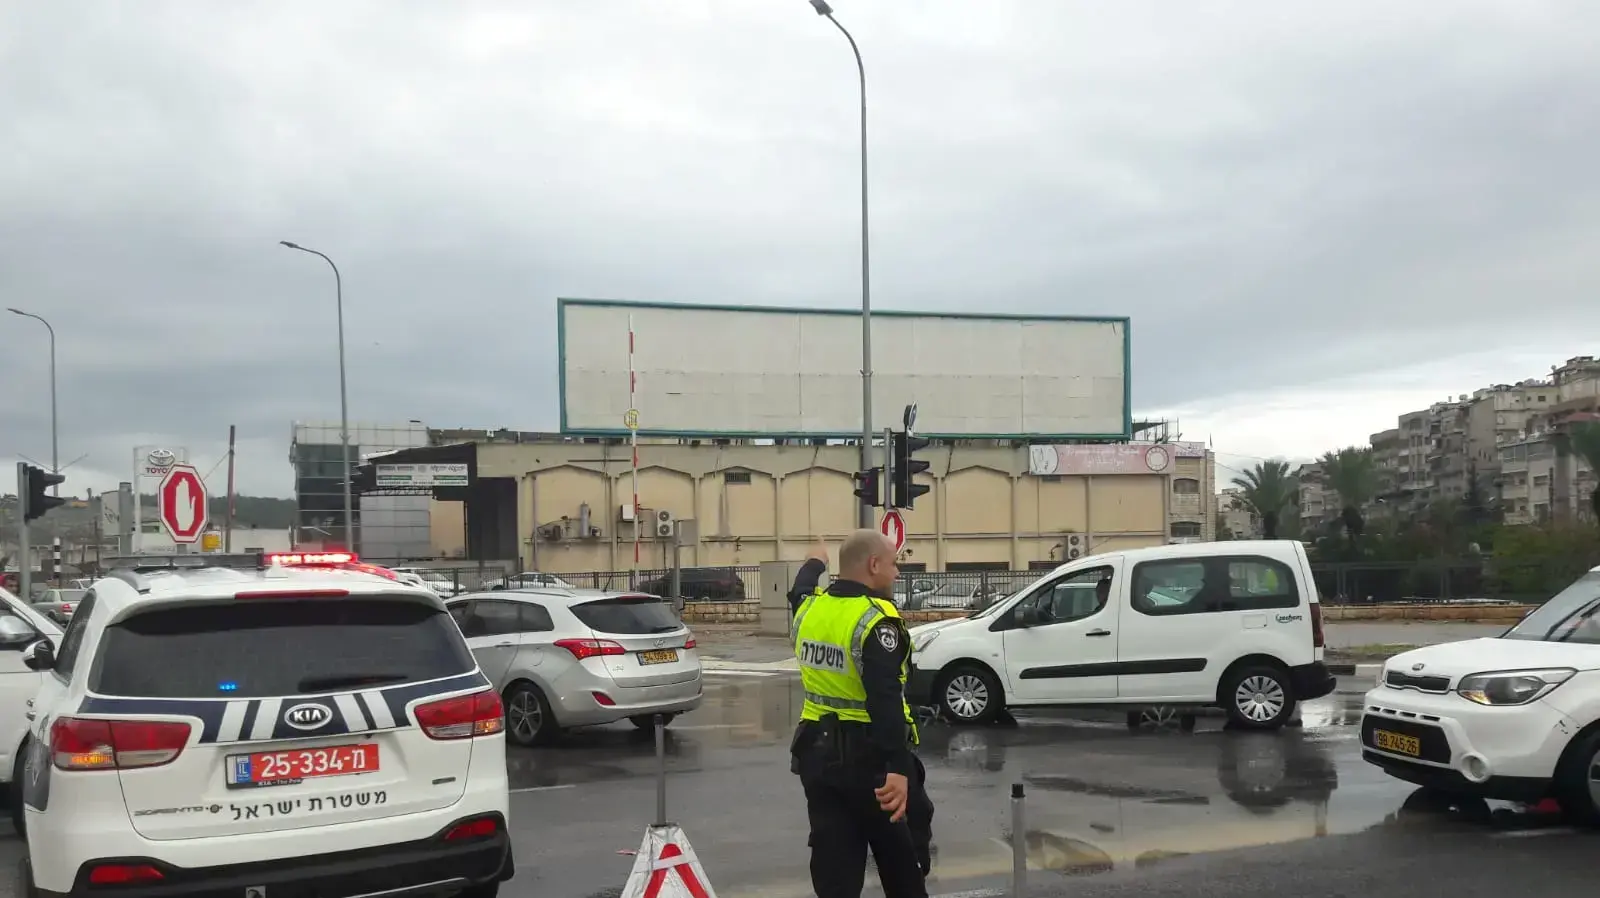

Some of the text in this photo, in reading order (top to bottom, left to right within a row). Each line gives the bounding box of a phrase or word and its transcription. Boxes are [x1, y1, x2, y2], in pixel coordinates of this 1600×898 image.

[801, 641, 845, 669] משטרה
[293, 709, 322, 722] KIA
[230, 790, 387, 820] משטרת ישראל
